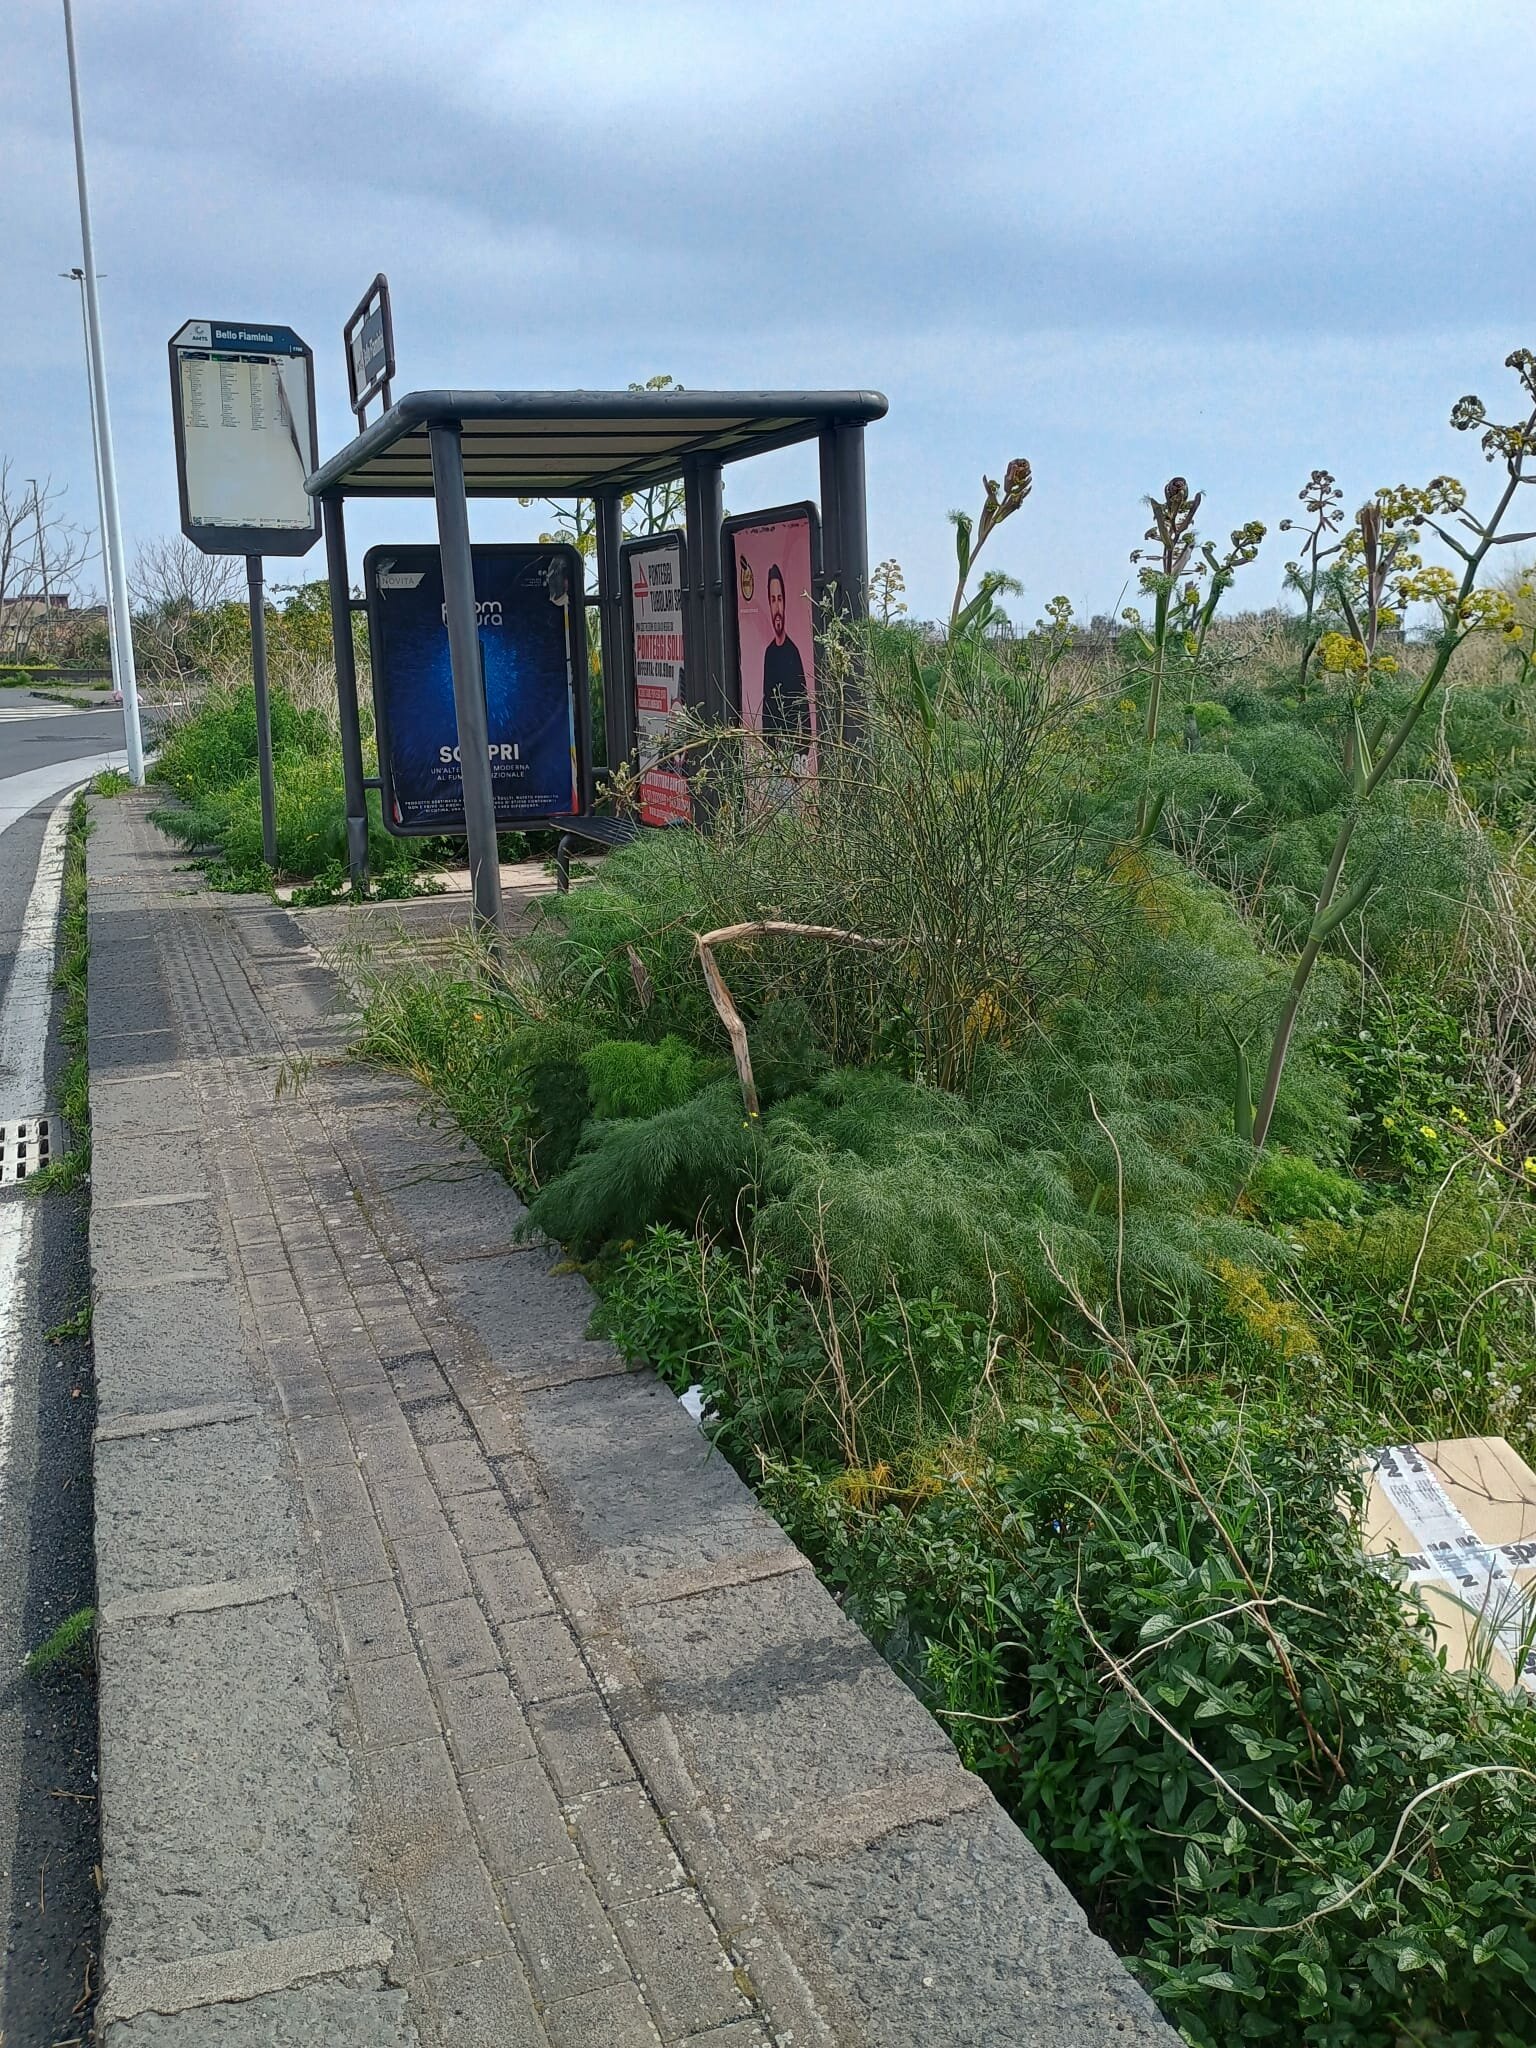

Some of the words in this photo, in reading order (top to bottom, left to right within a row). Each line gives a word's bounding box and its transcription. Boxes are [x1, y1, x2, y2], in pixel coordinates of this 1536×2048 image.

[215, 329, 237, 340] Bello
[239, 331, 274, 343] Flaminia
[648, 562, 672, 585] PONTEGGI
[650, 589, 674, 612] TUBOLARI
[637, 634, 666, 660] PONTEGGI
[439, 743, 520, 763] SCPRI
